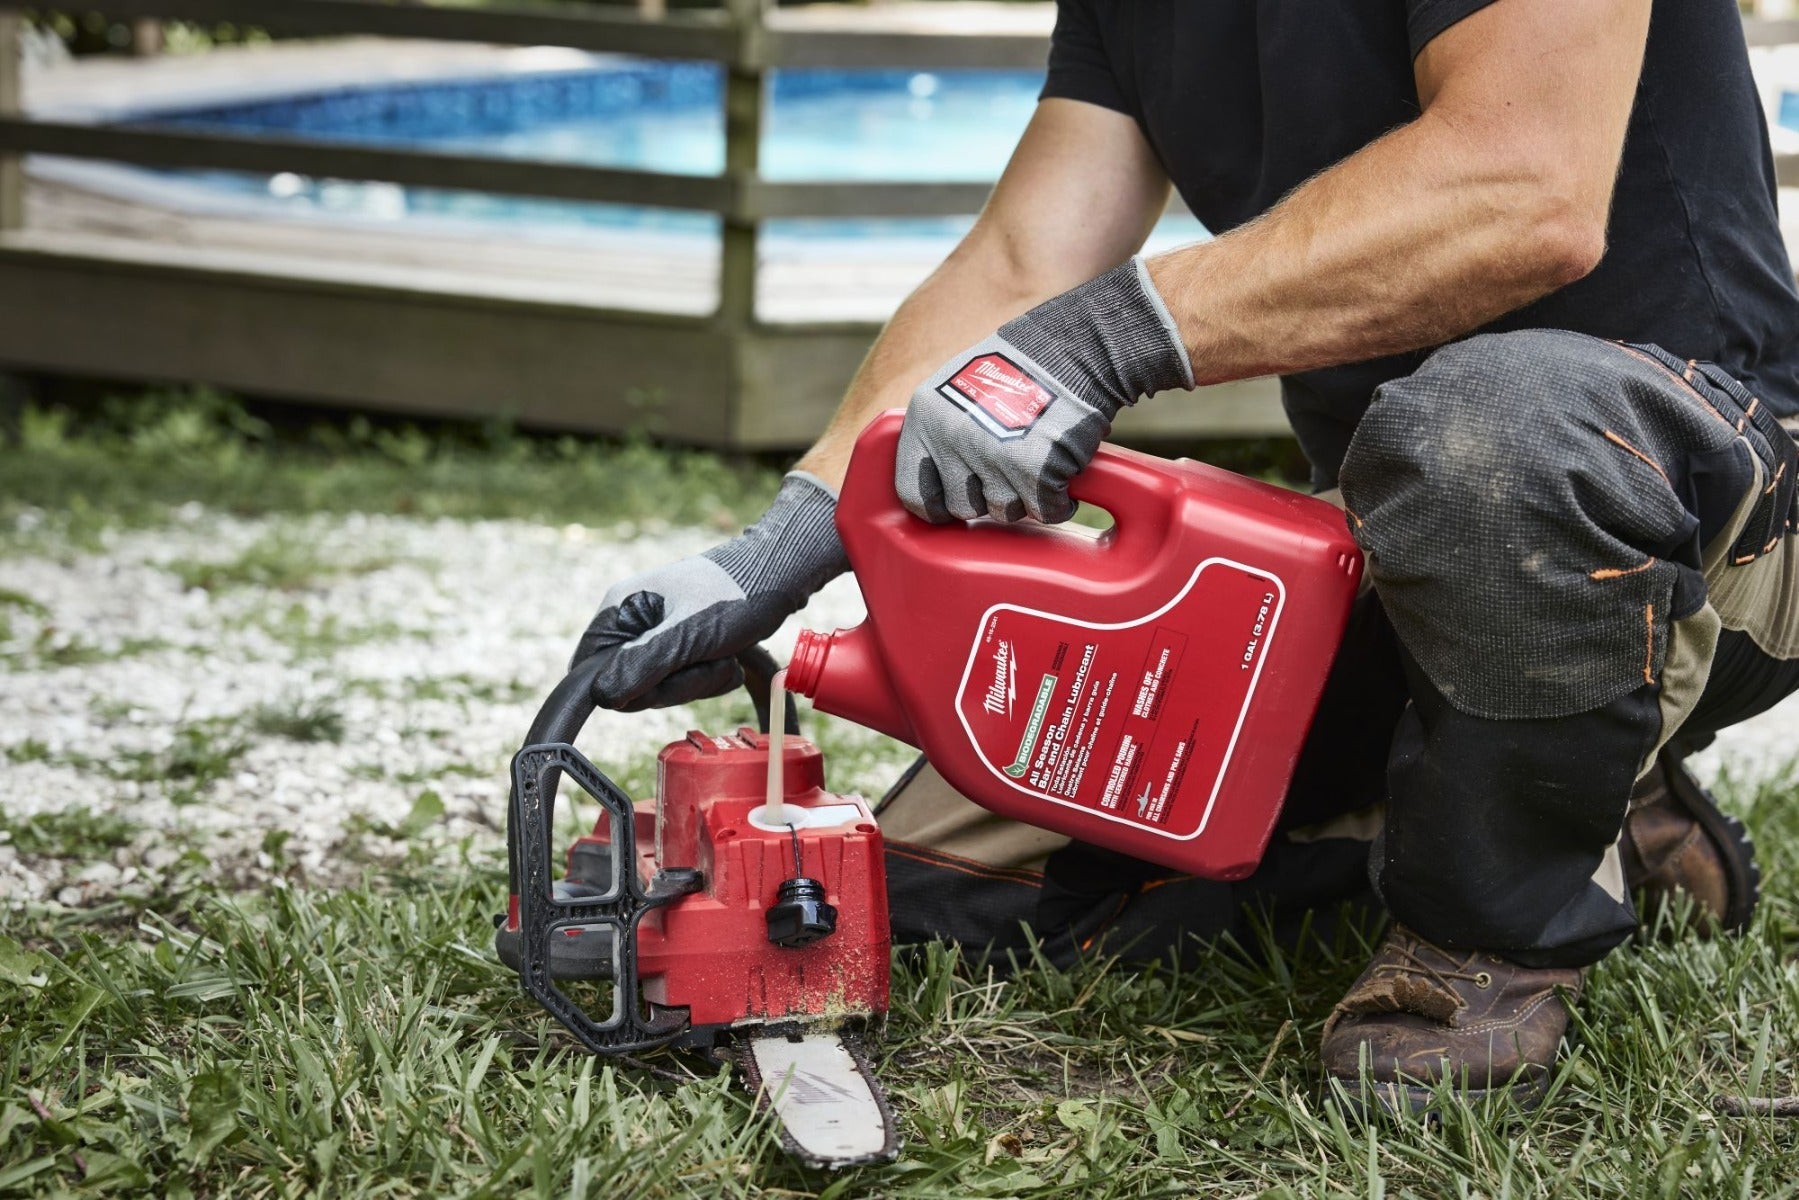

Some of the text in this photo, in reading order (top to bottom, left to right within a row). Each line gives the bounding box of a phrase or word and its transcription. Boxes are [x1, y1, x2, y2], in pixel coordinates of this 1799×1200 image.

[974, 361, 1033, 391] Milwaukee
[1244, 639, 1258, 662] GAL
[1252, 605, 1269, 636] (3.78
[1263, 592, 1274, 604] L)
[983, 640, 1008, 715] Milwaukee
[1083, 697, 1094, 716] barra
[1133, 671, 1154, 715] WASHES OFF
[1141, 693, 1154, 718] CLOTHES
[1150, 679, 1159, 692] AND
[1155, 649, 1170, 678] CONCRETE
[1018, 678, 1053, 763] BIODEGRADABLE
[1038, 644, 1093, 788] Bar and Chain Lubricant
[1029, 724, 1056, 785] All Season
[1081, 751, 1091, 766] pour
[1101, 765, 1121, 806] CONTROLLED
[1116, 734, 1132, 765] POURING
[1152, 812, 1160, 822] ALL
